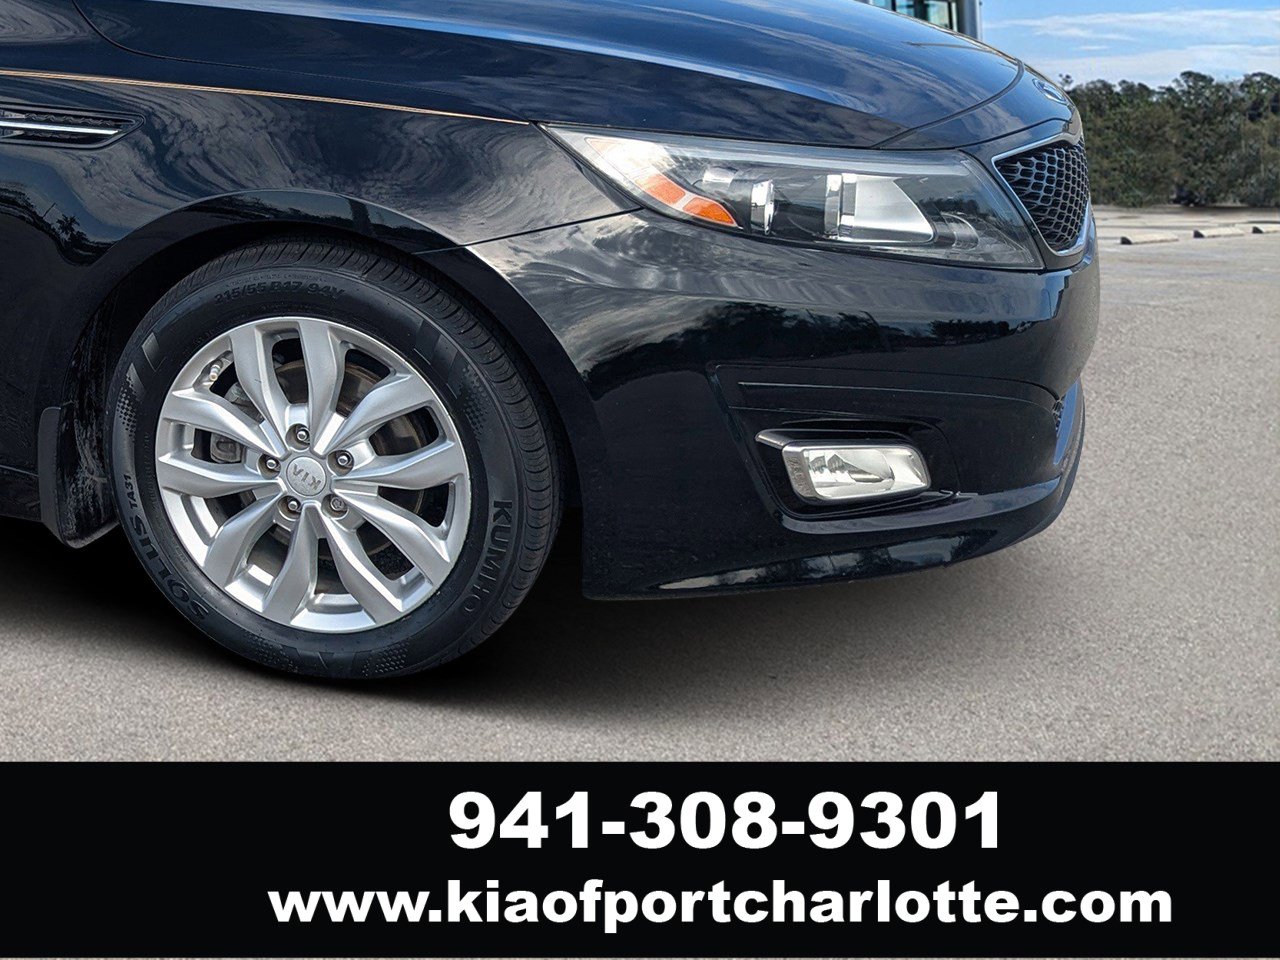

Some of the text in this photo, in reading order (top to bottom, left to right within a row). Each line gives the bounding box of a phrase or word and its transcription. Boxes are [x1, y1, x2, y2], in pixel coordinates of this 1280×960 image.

[292, 463, 323, 491] KIA
[123, 474, 211, 622] SOLUS TA31
[463, 499, 514, 615] KUMHO
